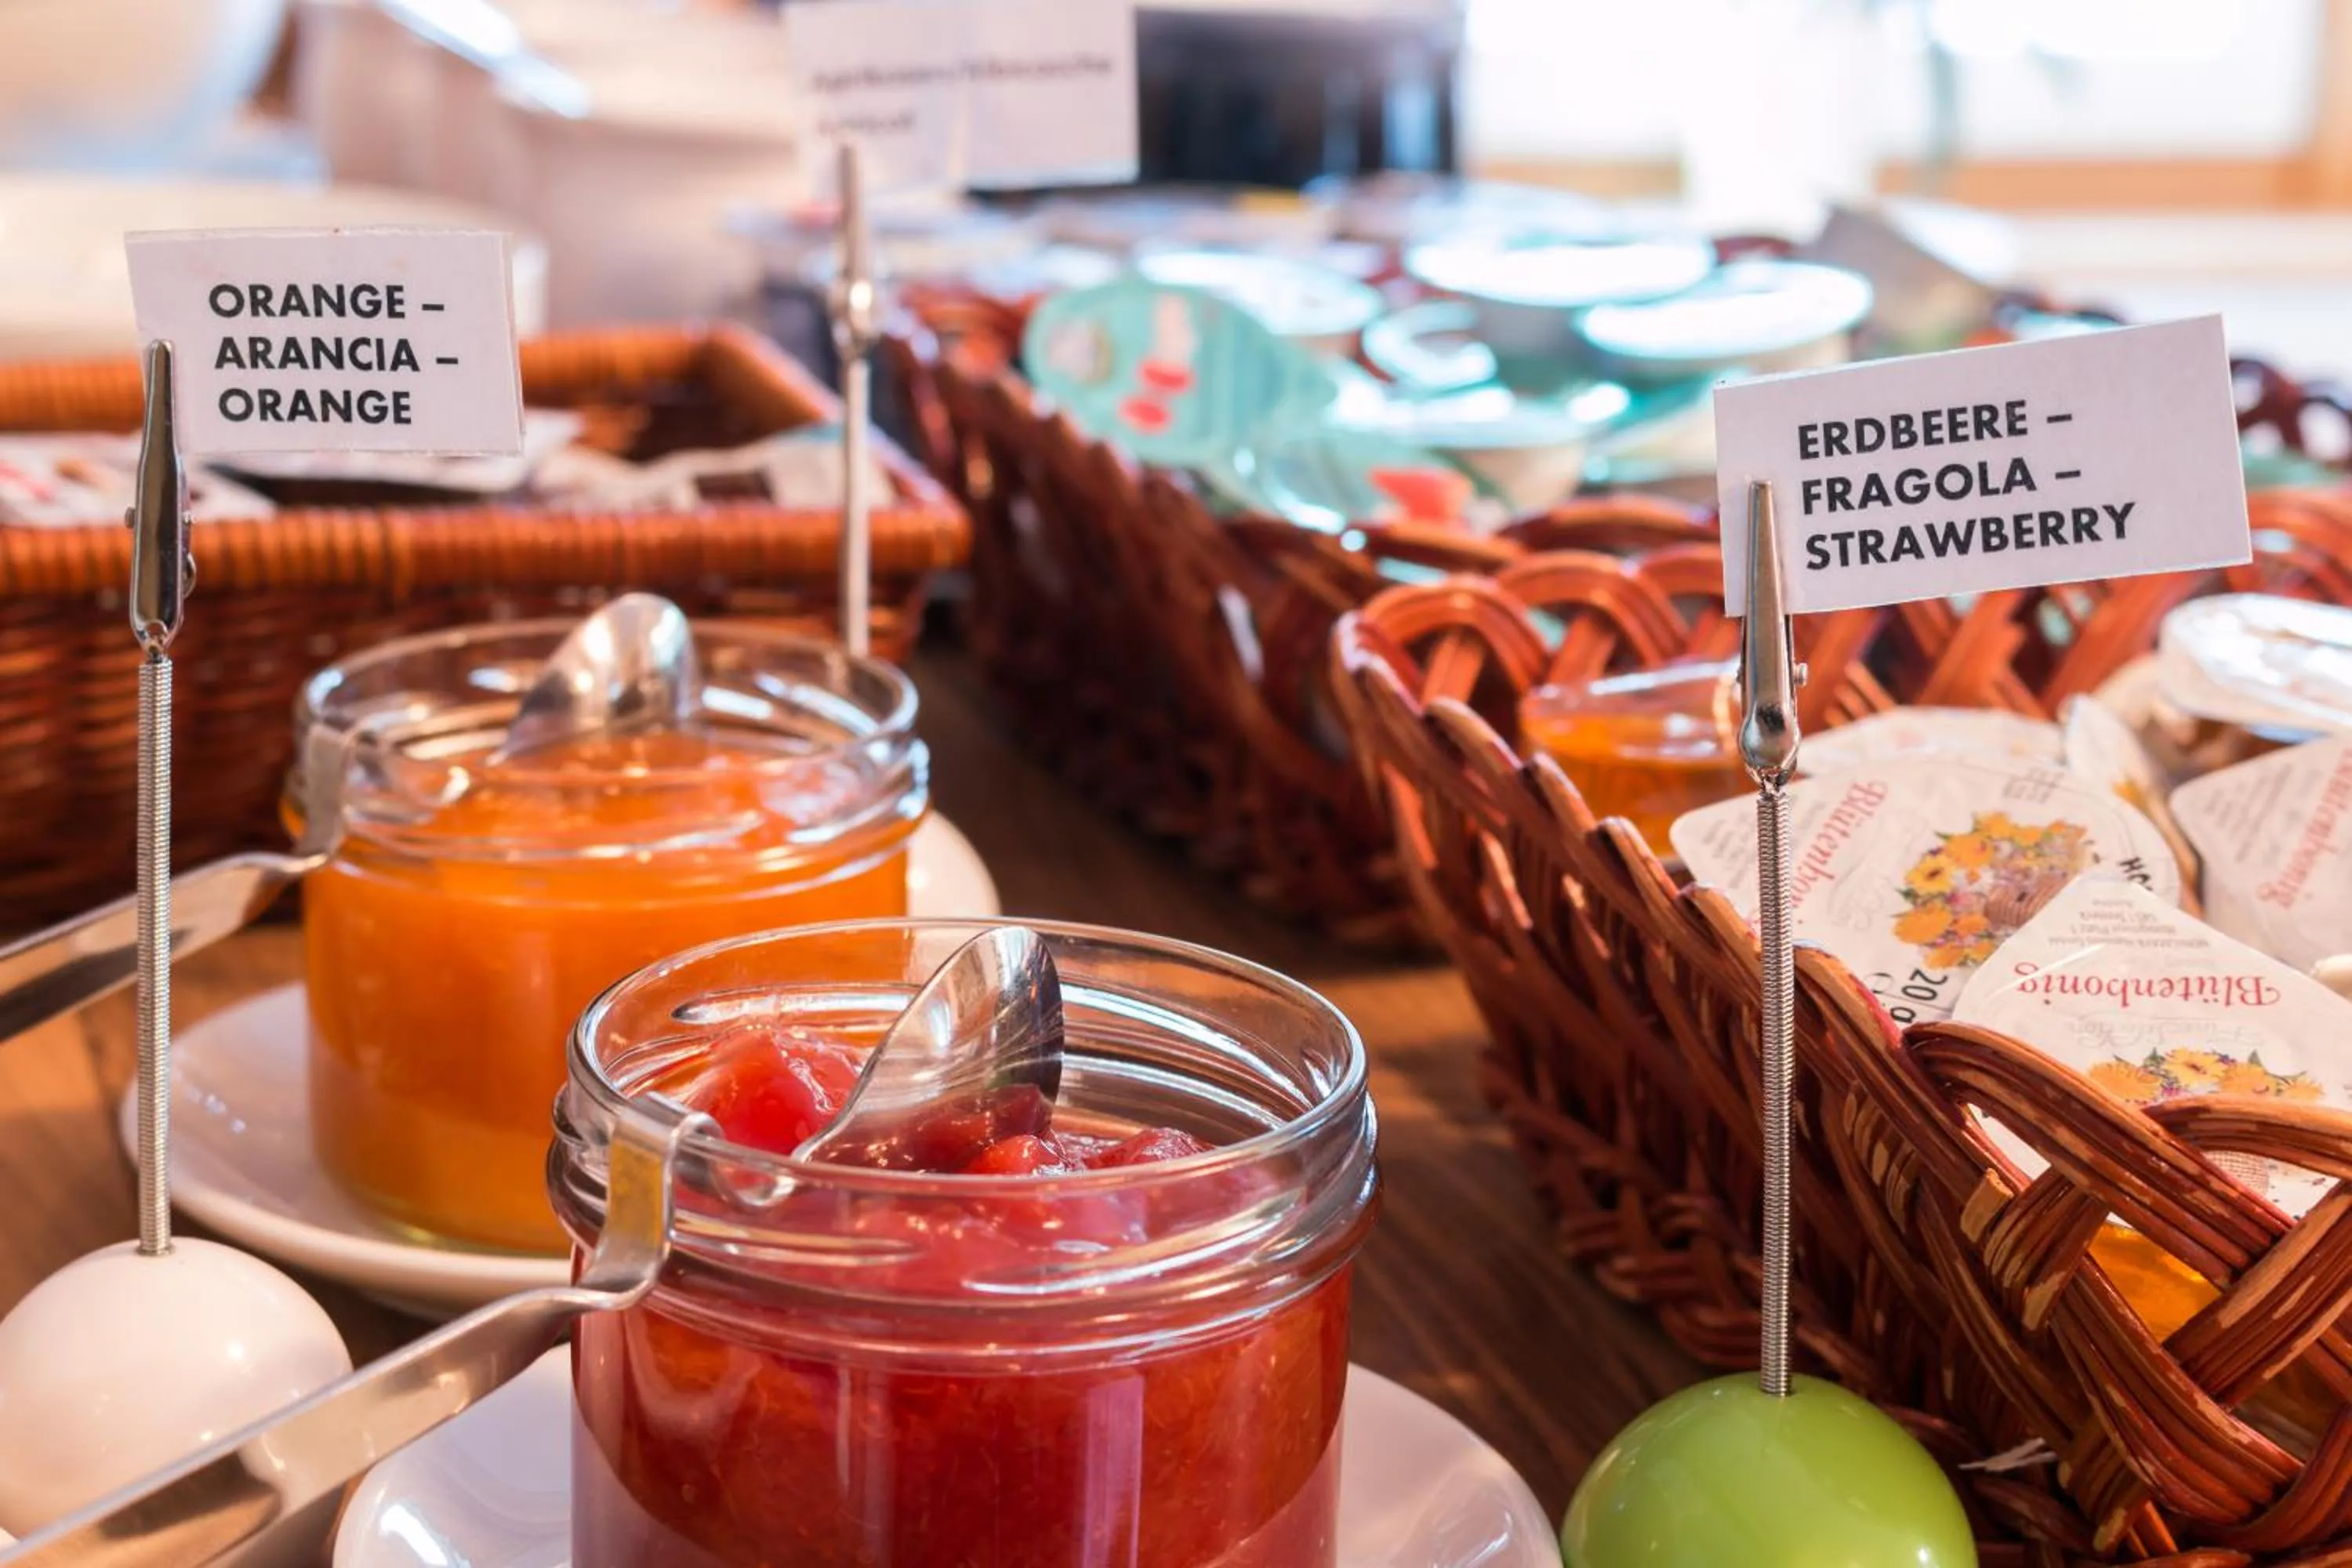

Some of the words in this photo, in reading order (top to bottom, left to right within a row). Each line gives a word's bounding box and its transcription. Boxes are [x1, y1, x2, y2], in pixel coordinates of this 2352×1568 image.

[209, 284, 405, 319] ORANGE
[215, 336, 420, 372] ARANCIA
[219, 388, 412, 424] ORANGE
[1798, 400, 2027, 460] ERDBEERE
[1802, 457, 2037, 515] FRAGOLA
[1806, 502, 2135, 570] STRAWBERRY
[1791, 781, 1888, 924] Blütenho
[1900, 968, 1948, 1001] 20
